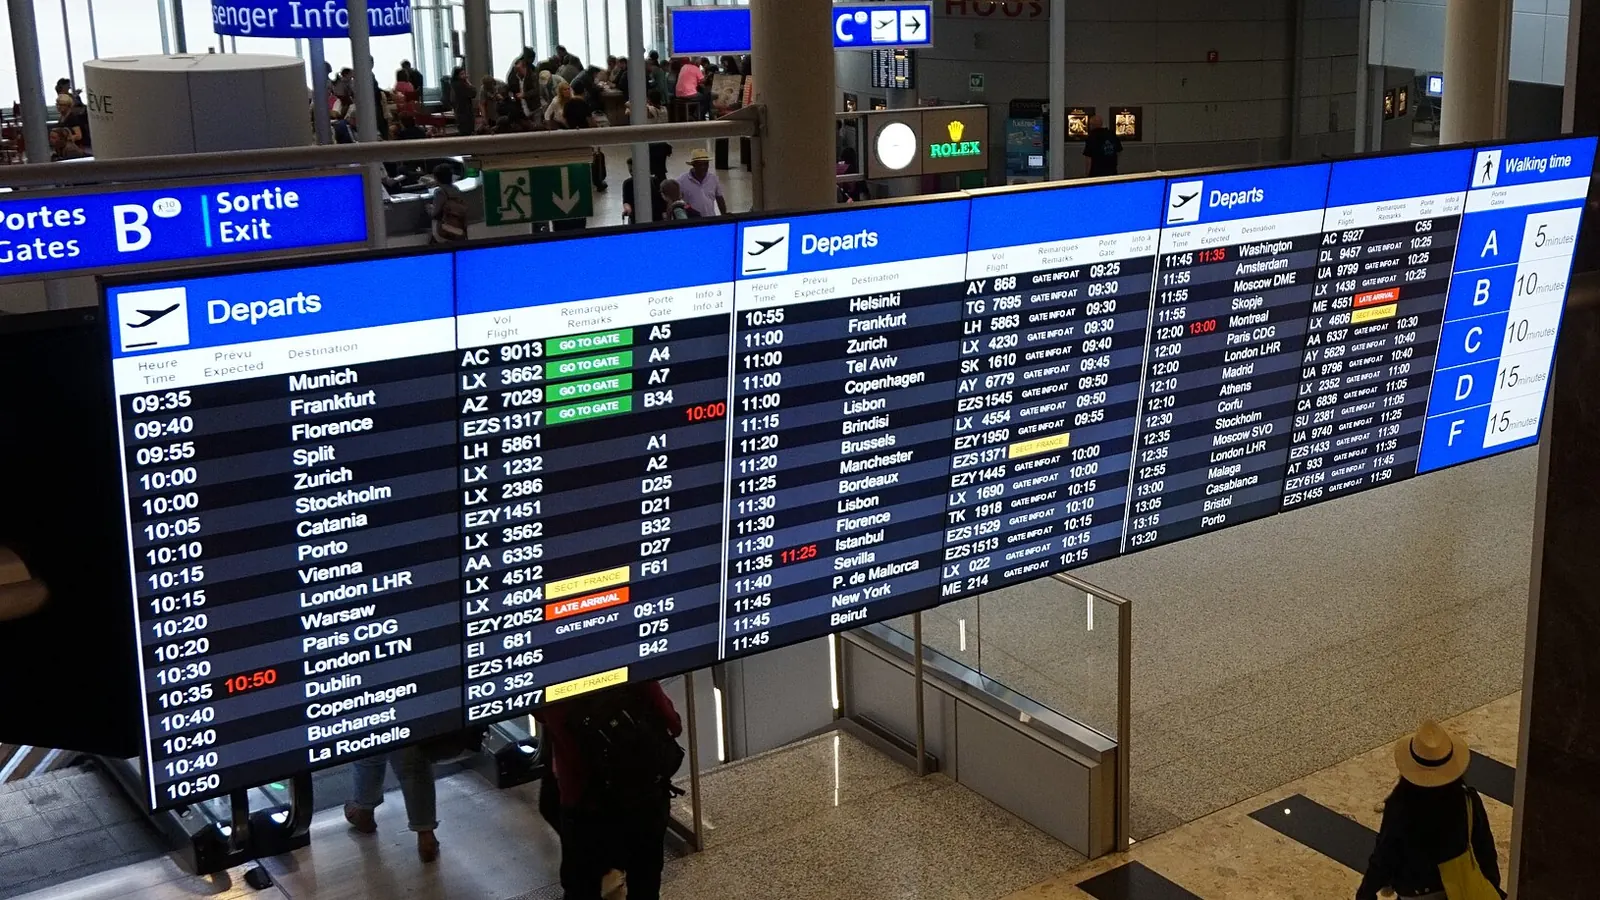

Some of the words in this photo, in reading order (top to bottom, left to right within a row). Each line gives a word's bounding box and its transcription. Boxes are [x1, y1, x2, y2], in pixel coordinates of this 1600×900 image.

[288, 1, 411, 28] Infomatio
[835, 13, 854, 42] C
[930, 141, 980, 158] ROLEX
[1505, 157, 1547, 173] Walking
[1549, 154, 1571, 168] time
[216, 187, 299, 214] Sortie
[1209, 187, 1264, 209] Departs
[113, 204, 152, 252] B
[219, 218, 272, 243] Exit
[802, 229, 878, 256] Departs
[1166, 253, 1193, 267] 11:45
[1199, 248, 1224, 262] 11:35
[1240, 241, 1292, 256] Washington
[1322, 233, 1337, 245] AC
[1342, 229, 1364, 242] 5927
[1415, 220, 1432, 232] C55
[1480, 229, 1498, 258] A
[648, 295, 674, 305] Porte
[693, 302, 711, 312] Info
[713, 301, 724, 310] at
[746, 308, 784, 326] 10:55
[850, 292, 900, 312] Helsinki
[967, 280, 986, 295] AY
[994, 276, 1016, 291] 868
[1090, 262, 1120, 278] 09:25
[1159, 307, 1186, 322] 11:55
[1232, 295, 1263, 310] Skopje
[1315, 284, 1328, 296] LX
[1336, 280, 1356, 292] 1438
[1406, 268, 1426, 281] 10:25
[1473, 278, 1491, 306] B
[207, 291, 322, 325] Departs
[493, 315, 511, 325] Vol
[560, 302, 619, 317] Remarques
[567, 316, 613, 328] Remarks
[649, 307, 672, 318] Gate
[1157, 325, 1183, 340] 12:00
[1190, 320, 1216, 333] 13:00
[1229, 310, 1269, 327] Montreal
[1312, 300, 1327, 312] ME
[1332, 296, 1352, 308] 4551
[486, 327, 518, 339] Flight
[1464, 326, 1483, 353] C
[138, 358, 178, 371] Heure
[288, 342, 358, 360] Destination
[743, 372, 781, 390] 11:00
[846, 359, 866, 373] Tel
[870, 355, 897, 370] Aviv
[963, 340, 979, 354] LX
[989, 334, 1018, 349] 4230
[1085, 318, 1114, 334] 09:30
[133, 390, 191, 413] 09:35
[290, 368, 357, 391] Munich
[462, 349, 489, 366] AC
[501, 342, 542, 361] 9013
[560, 340, 576, 350] GO
[577, 338, 592, 347] TO
[593, 333, 620, 345] GATE
[649, 324, 670, 340] A5
[143, 373, 176, 385] Time
[203, 361, 264, 377] Expected
[1455, 374, 1473, 401] D
[135, 416, 193, 439] 09:40
[291, 390, 375, 416] Frankfurt
[1144, 430, 1170, 445] 12:35
[1215, 411, 1261, 429] Stockholm
[1298, 399, 1311, 411] CA
[1316, 394, 1337, 407] 6836
[1447, 419, 1465, 447] F
[141, 467, 196, 490] 10:00
[293, 445, 335, 467] Split
[143, 492, 198, 515] 10:00
[294, 467, 352, 490] Zurich
[464, 442, 488, 460] LH
[502, 434, 540, 453] 5861
[687, 402, 725, 420] 10:00
[145, 517, 200, 540] 10:05
[296, 486, 391, 513] Stockholm
[736, 554, 772, 573] 11:35
[781, 545, 816, 563] 11:25
[836, 529, 884, 551] Istanbul
[948, 509, 965, 523] TK
[975, 501, 1002, 517] 1918
[1068, 480, 1096, 496] 10:15
[149, 566, 204, 589] 10:15
[298, 541, 348, 561] Porto
[153, 614, 207, 637] 10:20
[301, 584, 367, 607] London
[373, 571, 412, 592] LHR
[465, 555, 491, 572] AA
[503, 544, 543, 564] 6335
[642, 517, 670, 535] B32
[155, 638, 209, 661] 10:20
[301, 605, 375, 630] Warsaw
[157, 661, 211, 684] 10:30
[303, 632, 349, 652] Paris
[354, 619, 398, 640] CDG
[159, 684, 213, 708] 10:35
[225, 670, 276, 692] 10:50
[304, 651, 370, 675] London
[375, 638, 411, 658] LTN
[555, 602, 579, 614] LATE
[580, 593, 619, 608] ARRIVAL
[161, 707, 214, 731] 10:40
[306, 674, 361, 697] Dublin
[468, 642, 484, 658] EI
[504, 631, 531, 649] 681
[556, 622, 581, 634] GATE
[583, 616, 605, 628] INFO
[606, 613, 619, 622] AT
[634, 598, 674, 618] 09:15
[166, 752, 218, 776] 10:40
[308, 708, 396, 741] Bucharest
[168, 774, 220, 798] 10:50
[309, 748, 331, 762] La
[336, 726, 410, 755] Rochelle
